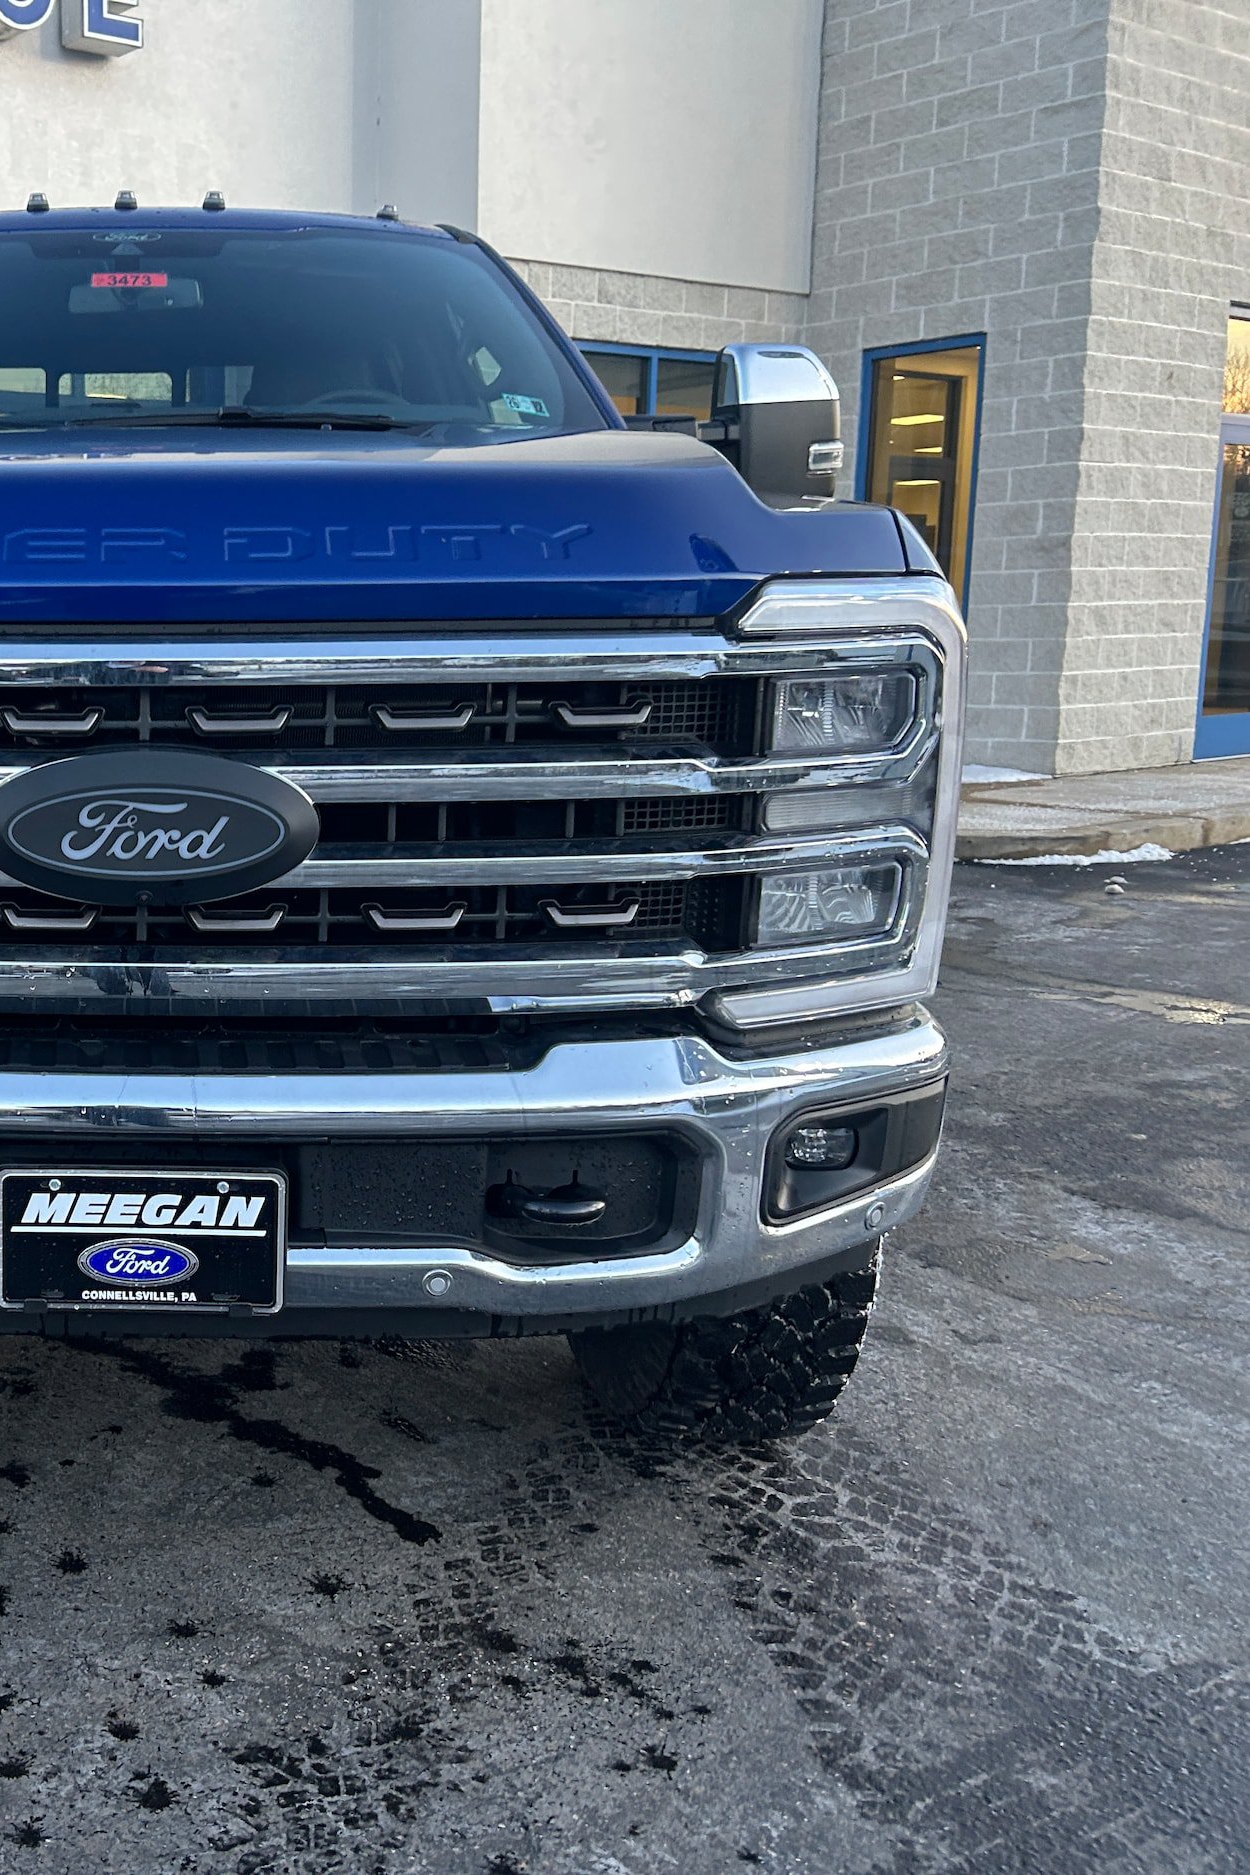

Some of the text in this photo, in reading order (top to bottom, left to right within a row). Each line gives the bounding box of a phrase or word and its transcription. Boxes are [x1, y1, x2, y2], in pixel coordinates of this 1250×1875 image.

[223, 523, 593, 562] DUTY
[60, 799, 230, 861] Ford
[20, 1193, 266, 1228] MEEGAN
[105, 1247, 170, 1275] Ford
[81, 1290, 198, 1303] CONNELLSVILLE, PA
